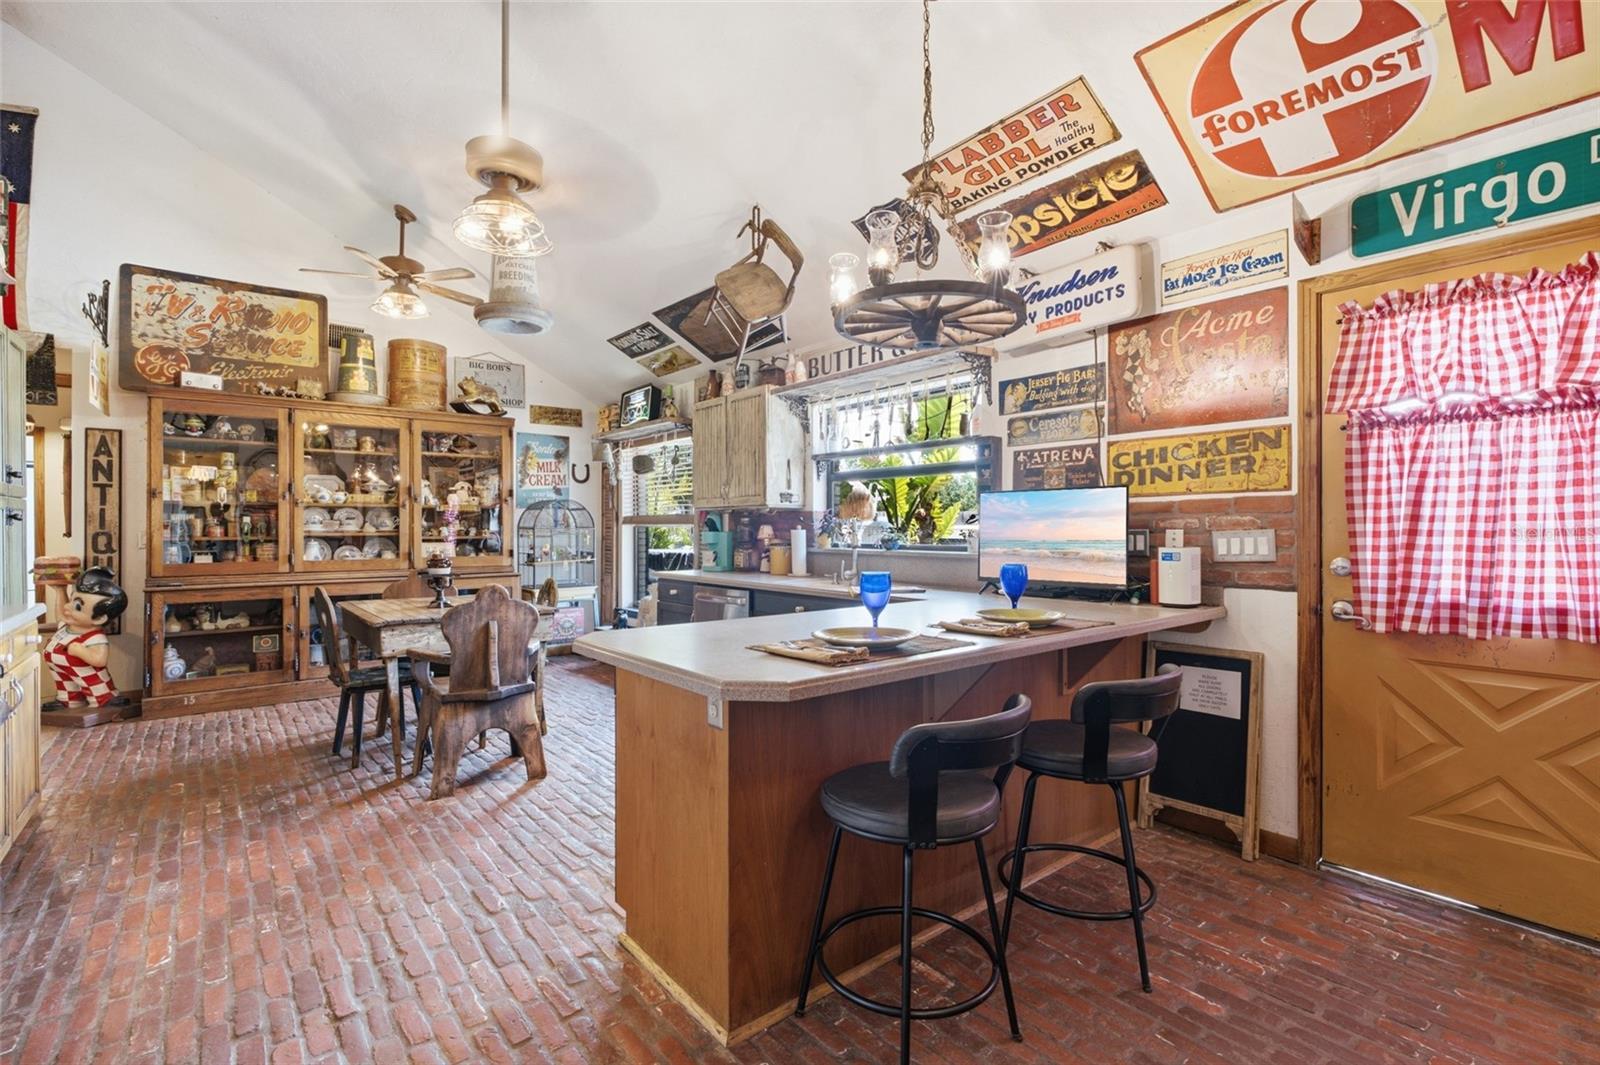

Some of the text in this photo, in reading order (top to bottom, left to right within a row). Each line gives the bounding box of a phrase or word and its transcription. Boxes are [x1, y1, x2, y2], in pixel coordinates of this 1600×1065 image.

[1054, 123, 1096, 148] Healthy
[1059, 118, 1080, 133] The
[951, 136, 1097, 210] BAKING POWDER
[963, 137, 1053, 186] GIRL
[1389, 161, 1567, 237] Virgo
[1016, 265, 1119, 304] Knudsen
[1045, 284, 1126, 319] PRODUCTS
[1164, 277, 1180, 293] Eat
[1160, 305, 1275, 347] Acme
[468, 361, 485, 369] BIG
[808, 344, 884, 379] BUTTER
[1111, 428, 1283, 470] CHICKEN
[528, 473, 567, 486] CREAM
[536, 461, 561, 473] MILK
[1113, 454, 1257, 487] DINNER
[183, 695, 196, 705] 15
